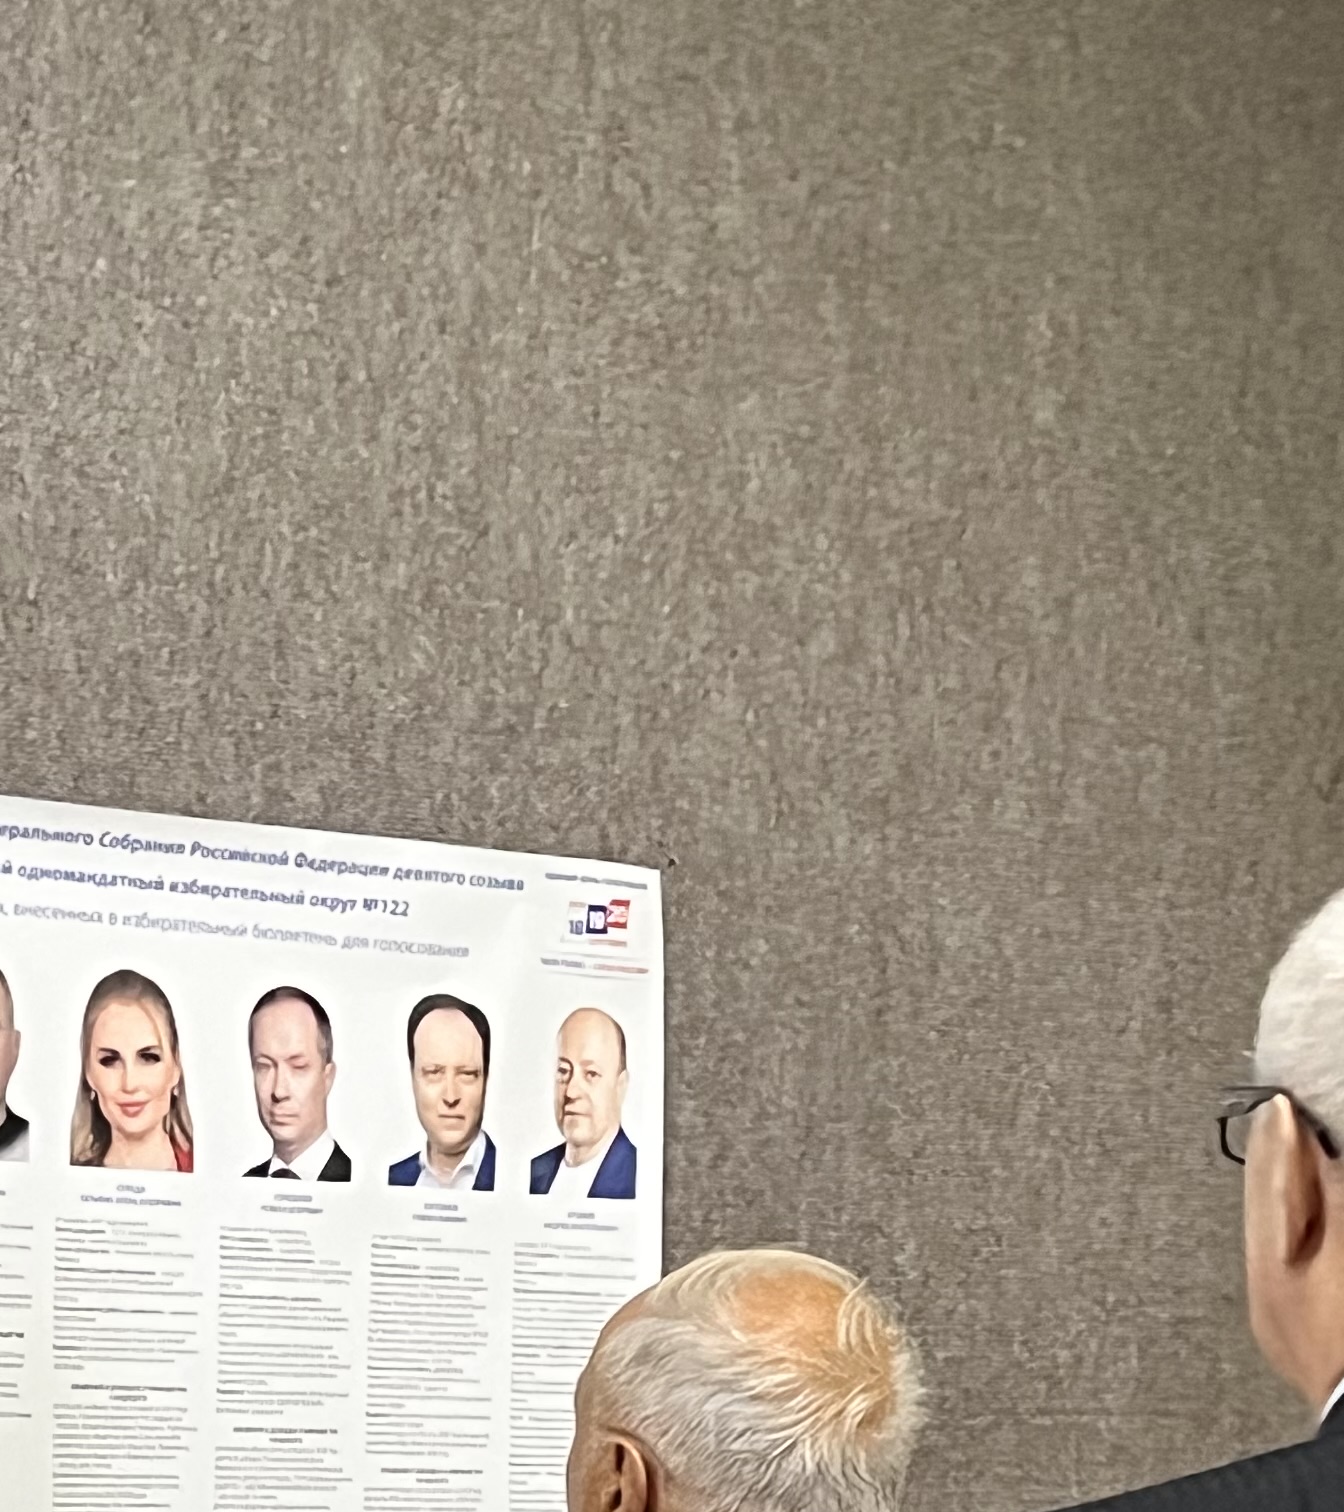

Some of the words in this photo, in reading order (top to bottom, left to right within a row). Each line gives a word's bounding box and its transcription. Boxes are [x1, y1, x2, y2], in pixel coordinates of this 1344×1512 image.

[17, 865, 164, 890] одномандатный
[169, 879, 305, 905] избирательный
[309, 895, 357, 914] округ
